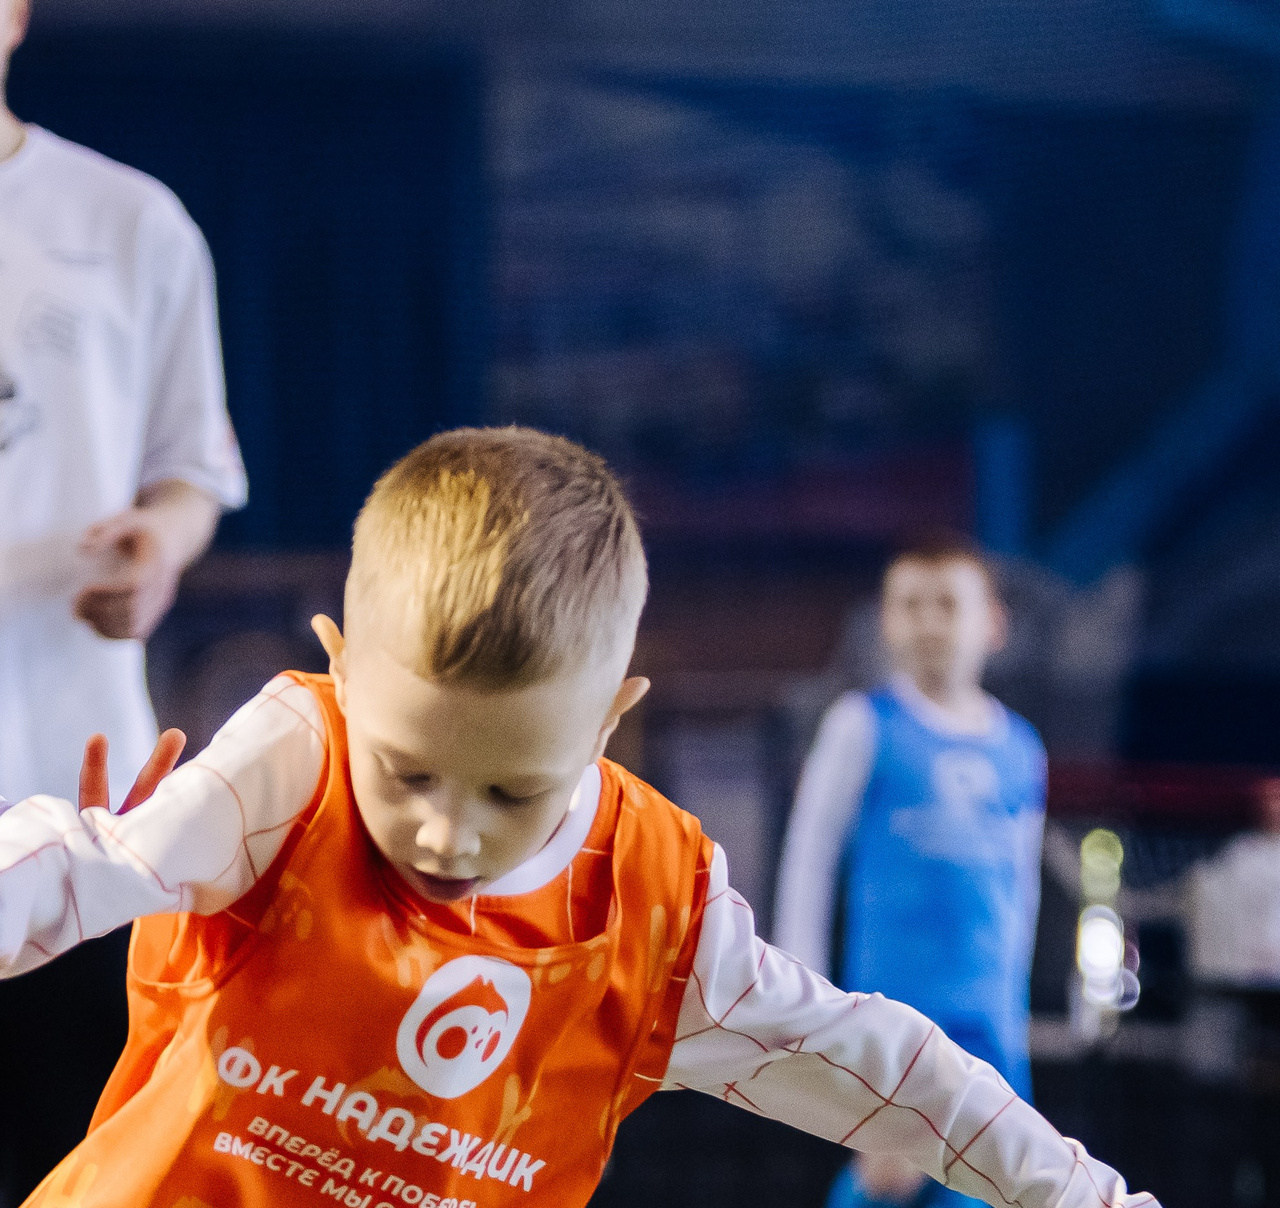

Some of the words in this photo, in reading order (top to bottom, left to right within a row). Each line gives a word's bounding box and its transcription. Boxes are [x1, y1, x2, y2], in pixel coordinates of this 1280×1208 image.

[217, 1045, 300, 1098] ФК
[300, 1075, 547, 1193] НАДЕЖДИК
[247, 1115, 356, 1181] ВПЕРЁД
[358, 1167, 383, 1188] К
[213, 1131, 321, 1187] ВМЕСТЕ
